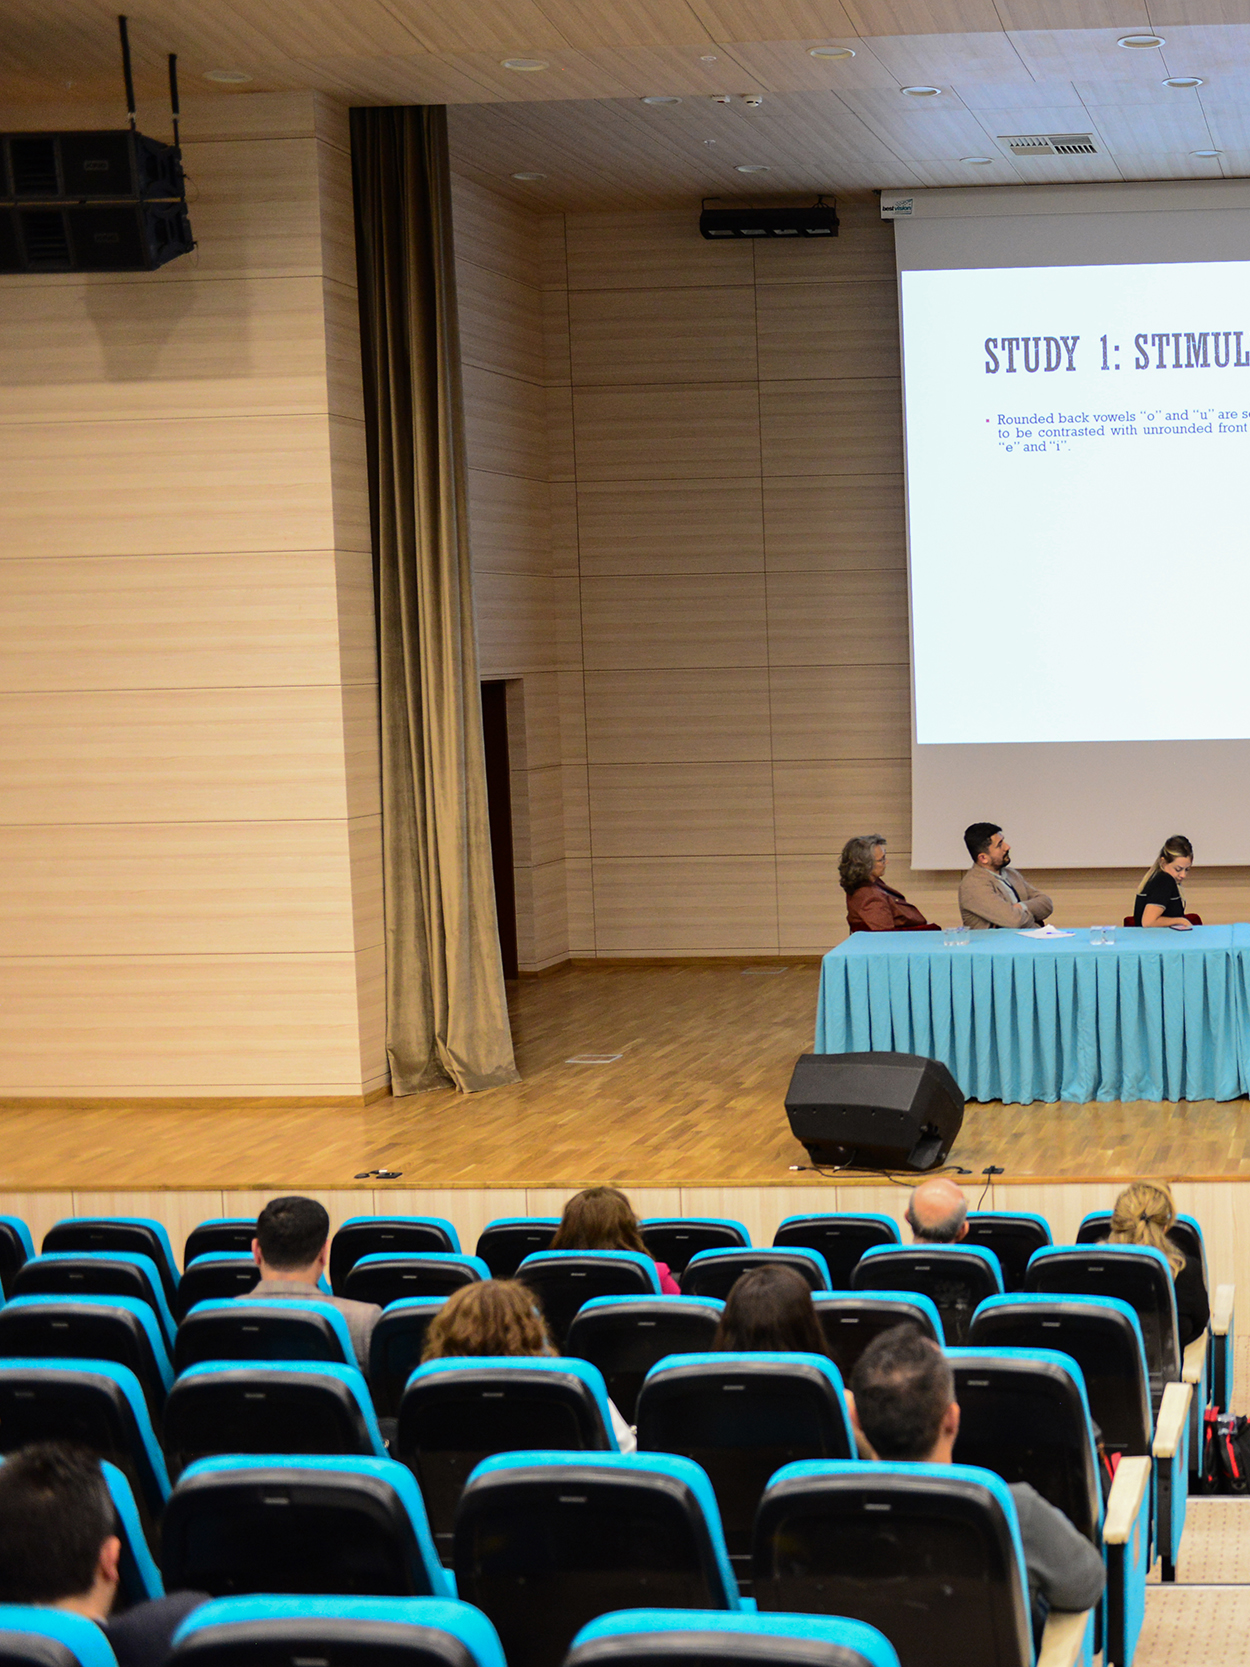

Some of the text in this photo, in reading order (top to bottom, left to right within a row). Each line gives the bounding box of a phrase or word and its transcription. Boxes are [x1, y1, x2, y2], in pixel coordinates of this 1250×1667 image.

[984, 335, 1080, 374] STUDY
[1100, 334, 1120, 371] 1:
[997, 413, 1054, 425] Rounded
[1058, 412, 1090, 424] back
[1093, 411, 1136, 422] vowels
[1165, 409, 1189, 421] and
[1218, 410, 1238, 419] are
[998, 429, 1010, 439] to
[1016, 427, 1033, 439] be
[1038, 425, 1105, 438] contrasted
[1110, 424, 1138, 436] with
[1143, 422, 1213, 435] unrounded
[1218, 422, 1248, 433] front
[1023, 440, 1047, 452] and
